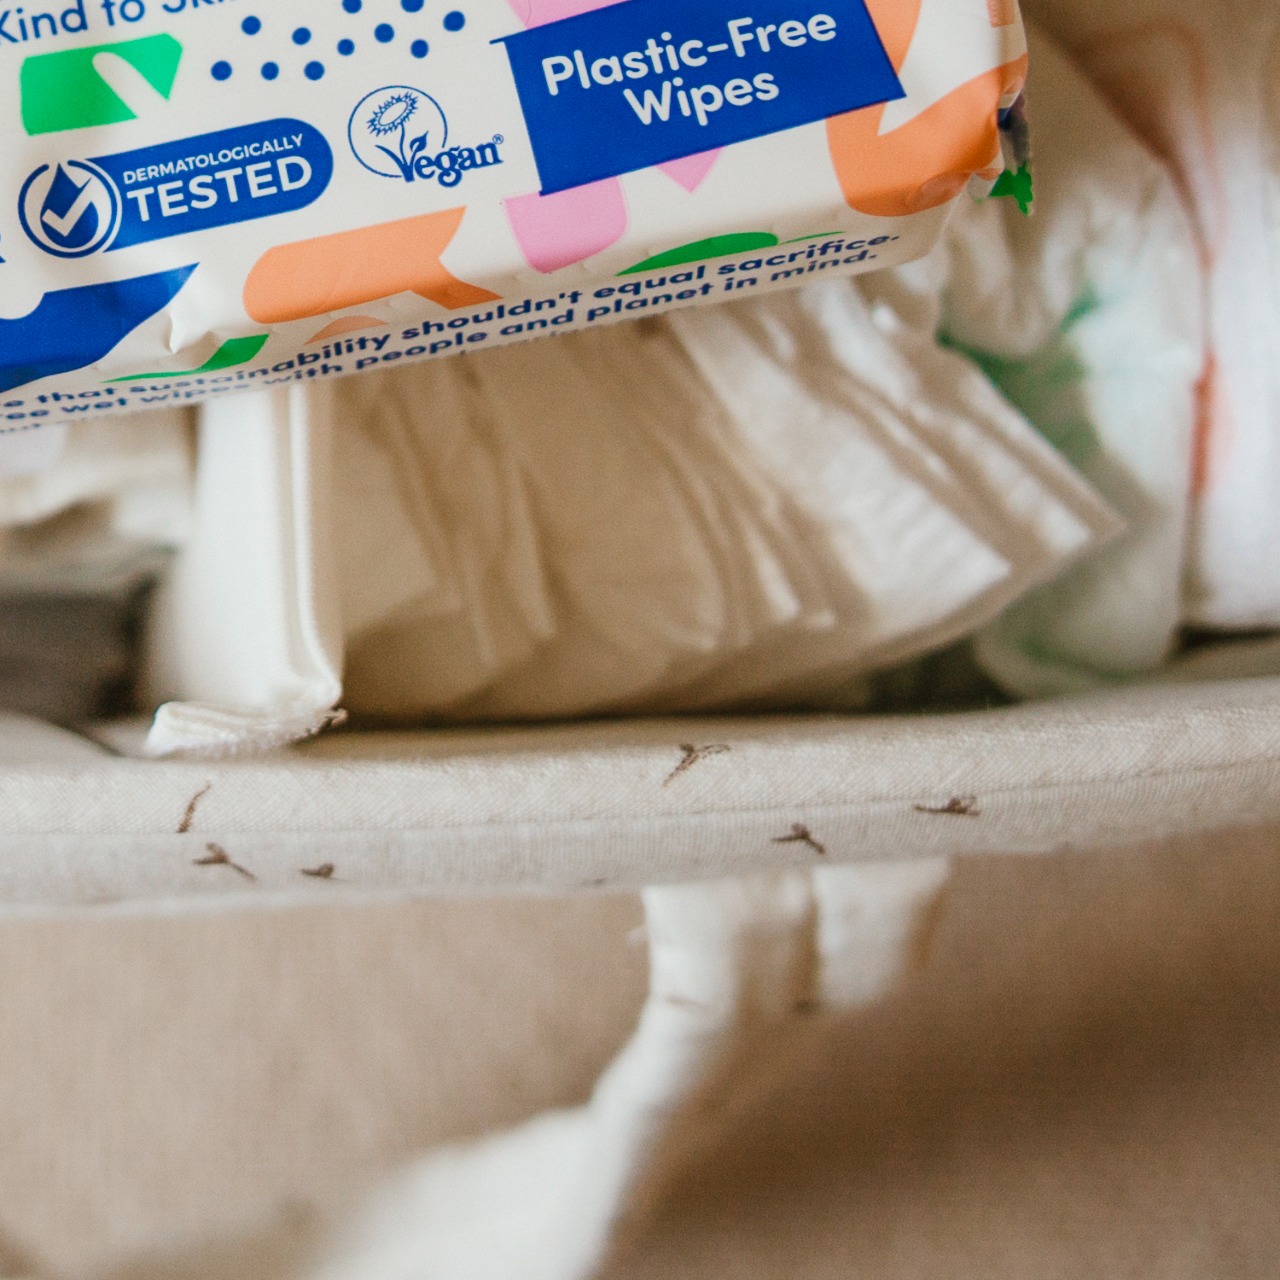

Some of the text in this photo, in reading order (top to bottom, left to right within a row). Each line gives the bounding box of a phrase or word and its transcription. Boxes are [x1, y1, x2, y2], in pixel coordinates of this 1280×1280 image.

[540, 9, 837, 97] Plastic-Free
[624, 64, 780, 131] Wipes
[122, 132, 305, 185] DERMATOLOGICALLY
[126, 154, 314, 223] TESTED
[36, 387, 118, 403] that
[129, 333, 392, 393] sustainability
[401, 290, 583, 341] shouldn't
[592, 265, 706, 301] equal
[716, 234, 901, 277] sacrifice.
[61, 397, 129, 413] wet
[263, 363, 344, 385] with
[355, 329, 488, 371] people
[499, 308, 575, 337] and
[586, 282, 715, 322] planet
[723, 274, 758, 292] in
[770, 249, 879, 283] mind.
